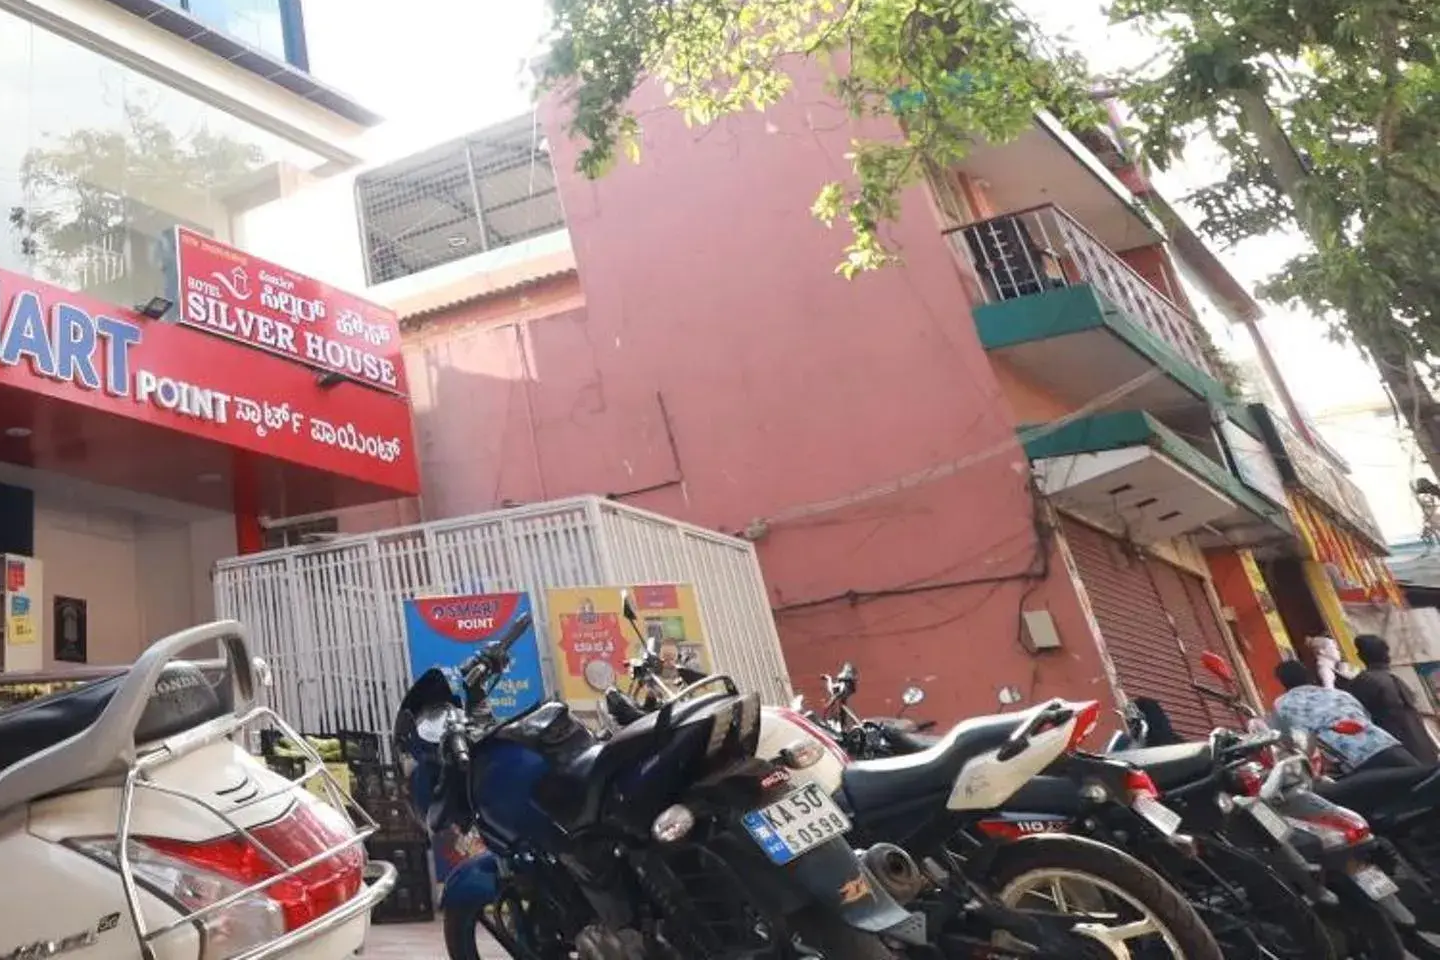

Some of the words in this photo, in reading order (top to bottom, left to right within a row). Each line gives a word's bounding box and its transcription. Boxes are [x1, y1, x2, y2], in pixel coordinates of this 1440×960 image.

[187, 291, 299, 354] SILVER
[303, 330, 398, 388] HOUSE
[135, 367, 232, 426] POINT
[457, 618, 495, 630] POINT
[766, 803, 796, 830] KA
[790, 787, 823, 815] 50
